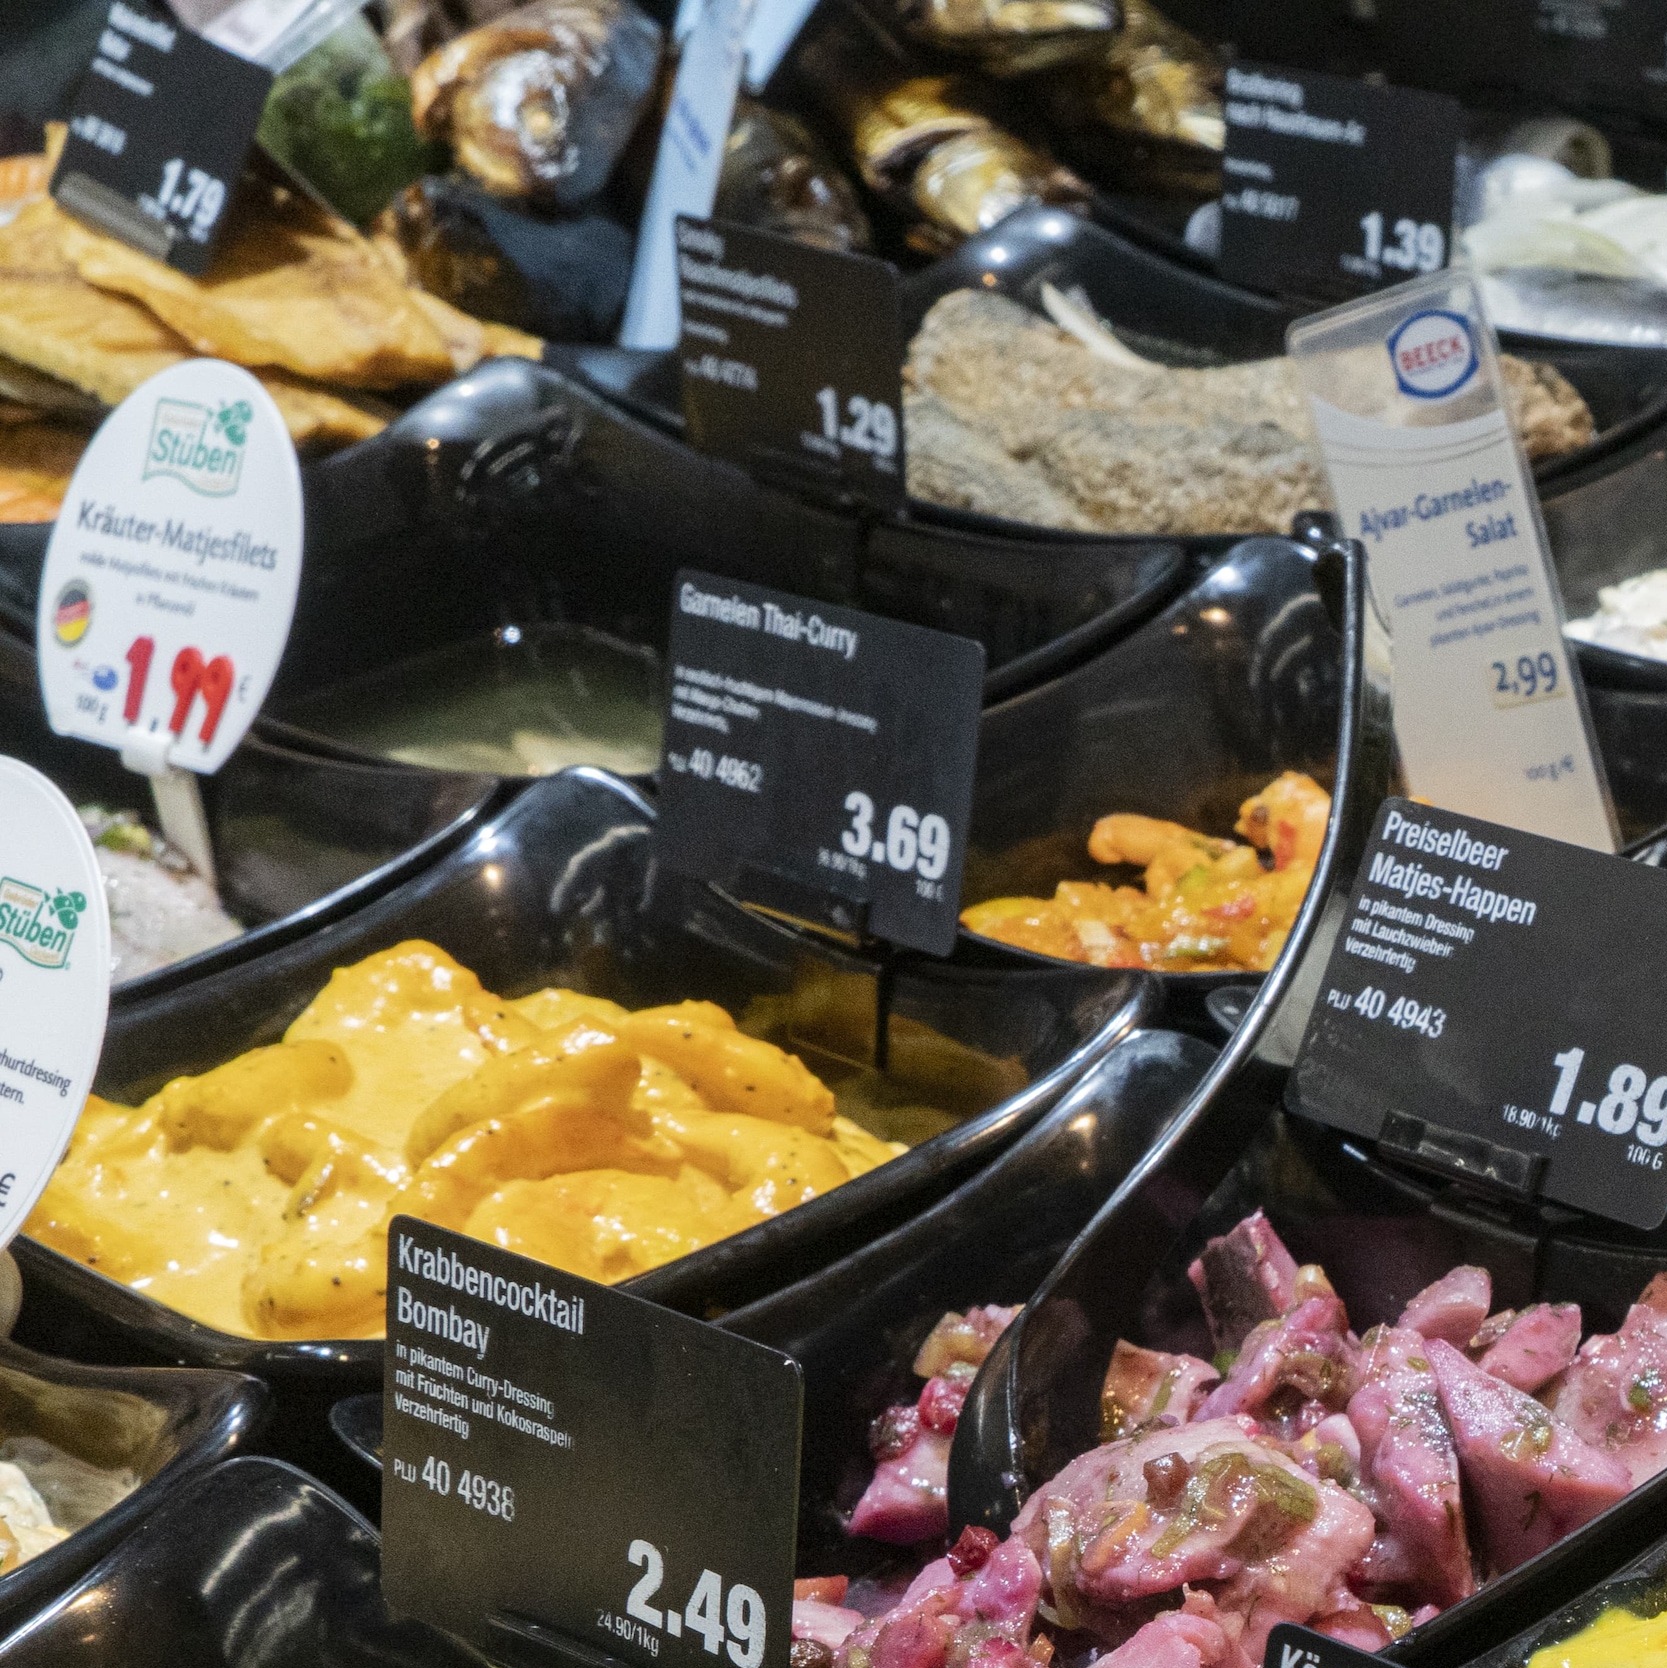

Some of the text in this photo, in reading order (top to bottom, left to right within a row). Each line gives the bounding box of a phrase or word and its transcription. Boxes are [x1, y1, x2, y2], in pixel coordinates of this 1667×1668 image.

[160, 157, 226, 228] 1.79
[1359, 211, 1444, 272] 1.39
[1399, 335, 1465, 371] BEECK
[152, 416, 237, 476] Stüben
[816, 386, 897, 457] 1.29
[76, 499, 278, 573] Kräuter-Matjesfilets
[1359, 476, 1512, 544] Ajvar-Garnelen-
[1464, 510, 1516, 550] Salat
[680, 581, 859, 660] Garnelen Thai-Curry
[1494, 650, 1557, 696] 2,99
[842, 790, 950, 881] 3.69
[1382, 810, 1509, 871] Preiselbeer
[1368, 852, 1537, 925] Matjes-Happen
[1345, 936, 1417, 974] Verzehrfertig
[1354, 985, 1447, 1039] 40 4943
[0, 1048, 72, 1098] hurtdressing
[398, 1233, 585, 1335] Krabbencocktail
[397, 1286, 490, 1360] Bombay
[410, 1347, 555, 1420] pikantem Curry-Dressing
[417, 1373, 468, 1410] Früchten
[395, 1391, 469, 1440] Verzehrfertig
[394, 1455, 515, 1522] PLU 40 4938
[597, 1609, 659, 1657] 24.90/1kg
